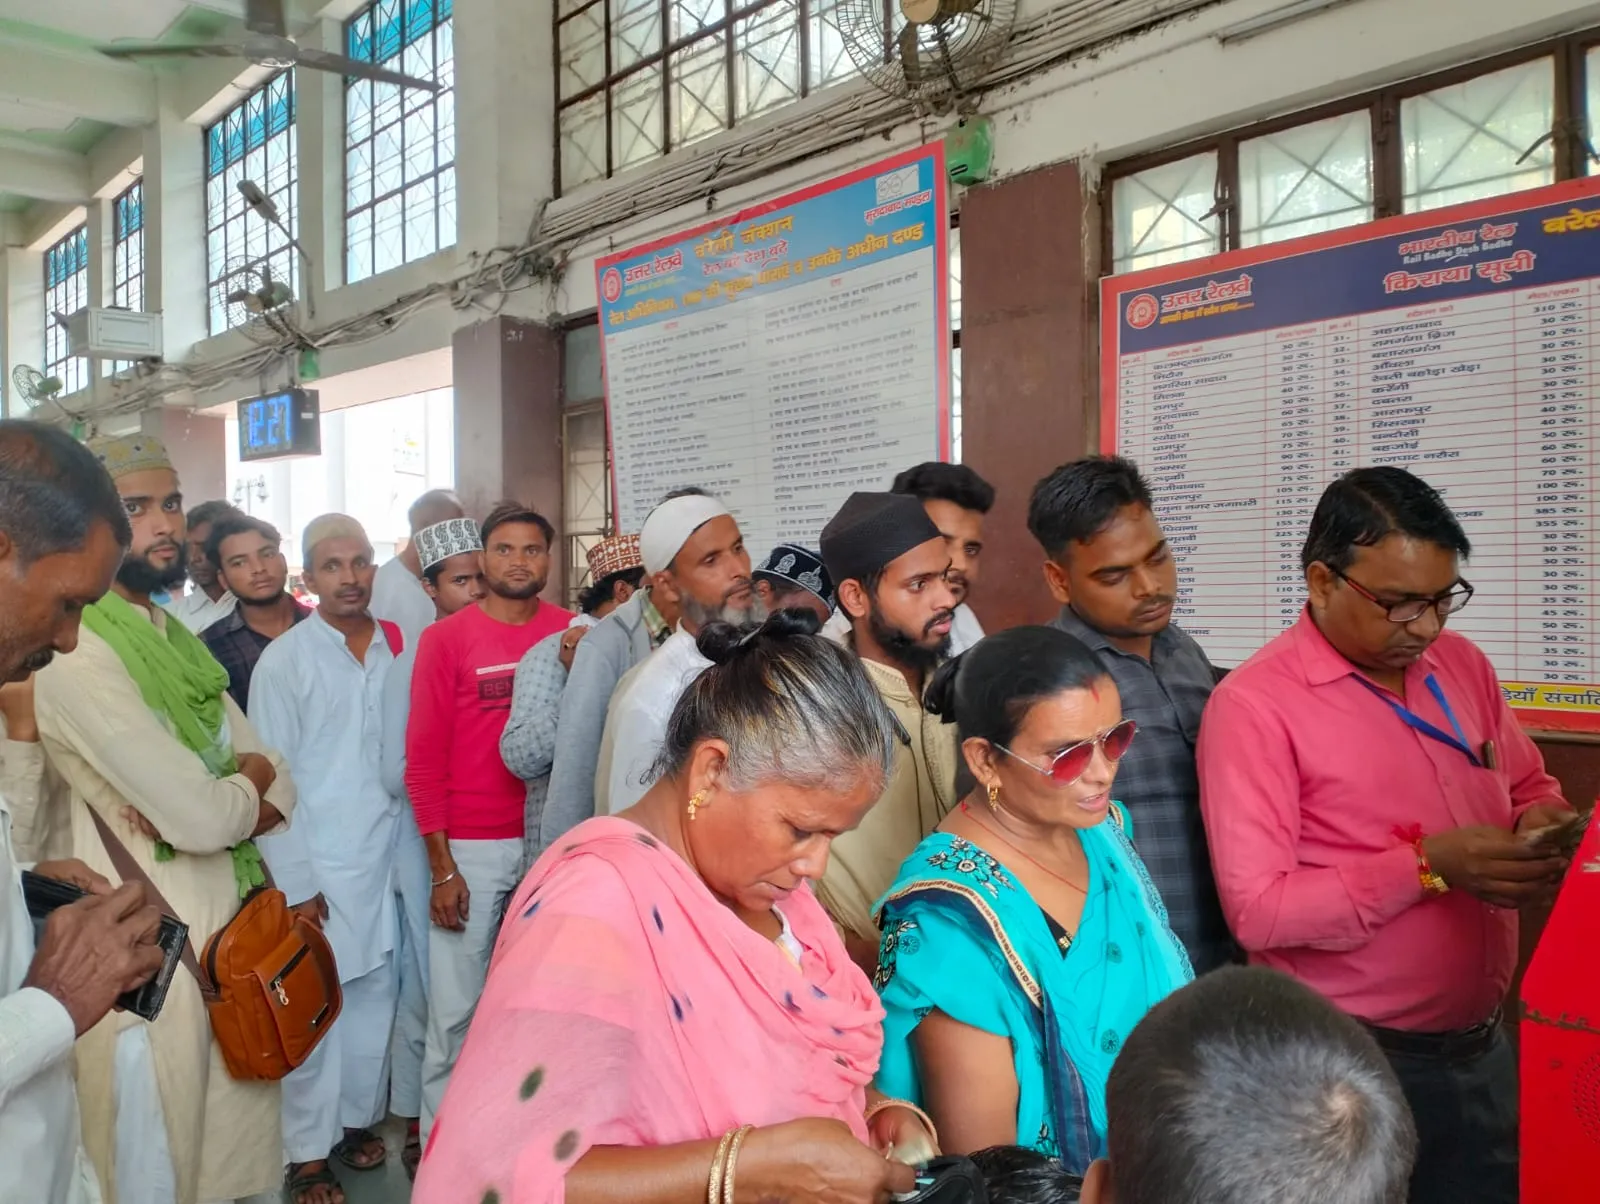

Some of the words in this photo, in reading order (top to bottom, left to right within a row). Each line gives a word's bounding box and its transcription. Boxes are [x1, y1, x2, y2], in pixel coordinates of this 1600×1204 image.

[1399, 229, 1476, 255] भारतीय
[1480, 222, 1518, 240] रेल
[624, 264, 651, 285] उत्तर
[654, 249, 683, 273] रेलवे
[1384, 265, 1473, 293] किराया
[1476, 250, 1536, 283] सूची
[1161, 288, 1204, 312] उत्तर
[1206, 273, 1252, 301] रेलवे
[1534, 304, 1556, 313] 310
[1541, 316, 1556, 325] 30
[1541, 329, 1557, 338] 30
[1541, 342, 1556, 350] 30
[1541, 356, 1557, 364] 30
[1541, 367, 1557, 375] 30
[1542, 380, 1558, 388] 30
[1541, 393, 1556, 401] 35
[1539, 418, 1557, 426] 40
[1541, 431, 1557, 439] 50
[1540, 443, 1558, 451] 60
[1540, 456, 1557, 464] 60
[1541, 469, 1557, 477] 70
[1536, 482, 1558, 490] 100
[1536, 494, 1559, 502] 100
[1535, 507, 1557, 515] 385
[1535, 520, 1558, 528] 355
[1542, 545, 1558, 553] 30
[1543, 570, 1558, 578] 30
[1541, 596, 1557, 604] 35
[1541, 609, 1558, 617] 45
[1542, 634, 1558, 642] 50
[1543, 659, 1559, 667] 30
[1543, 672, 1559, 680] 30
